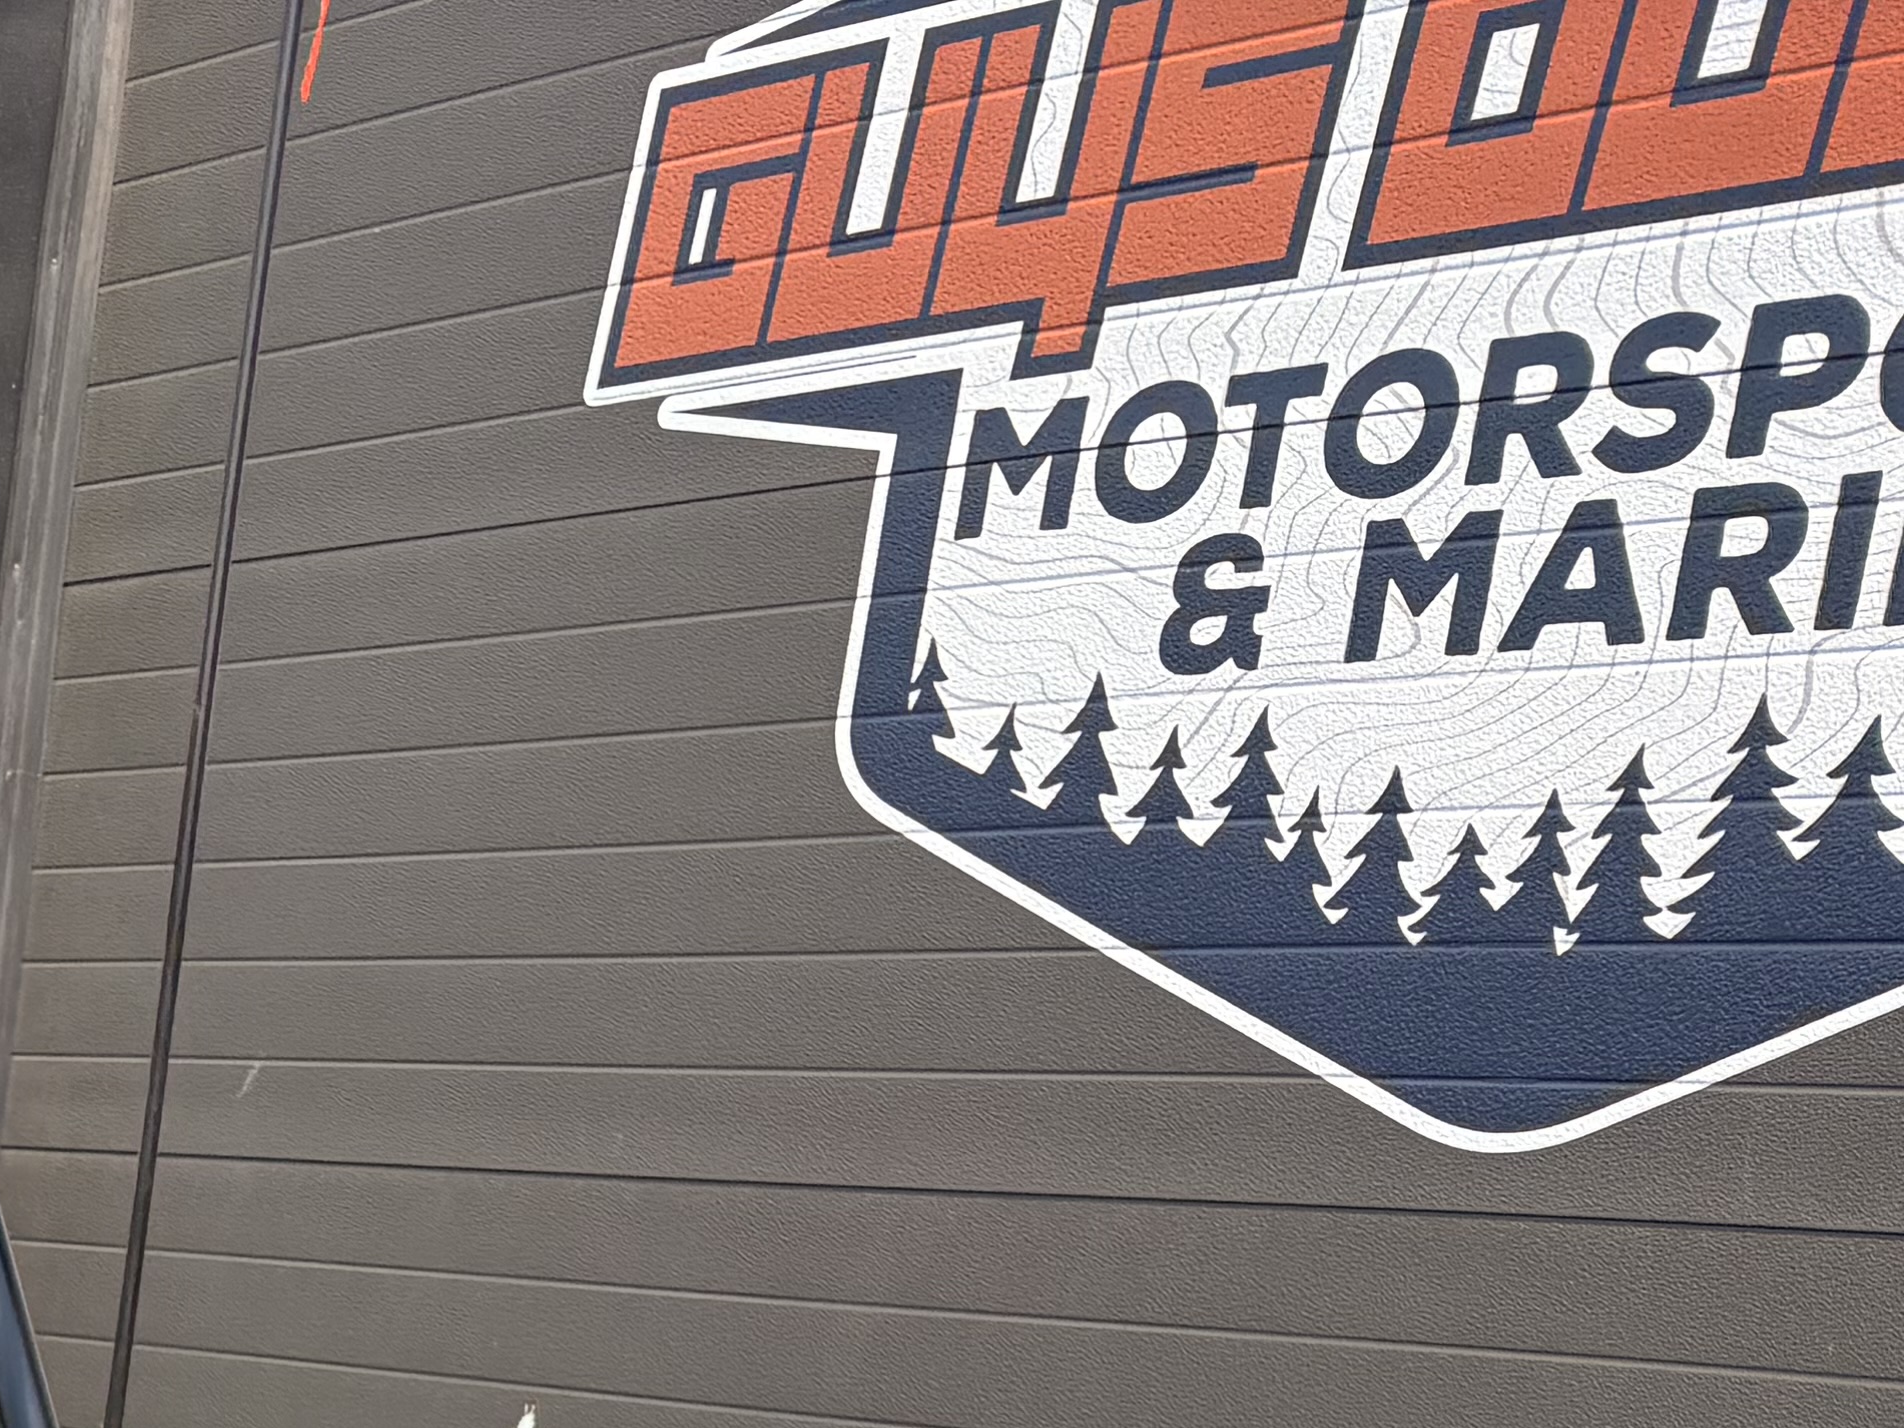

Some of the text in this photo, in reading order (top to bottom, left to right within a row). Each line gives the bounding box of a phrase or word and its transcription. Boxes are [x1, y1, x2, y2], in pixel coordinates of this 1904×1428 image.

[612, 0, 1904, 368] GUYS OU
[954, 294, 1904, 541] MOTORSP
[1159, 470, 1904, 676] & MARI
